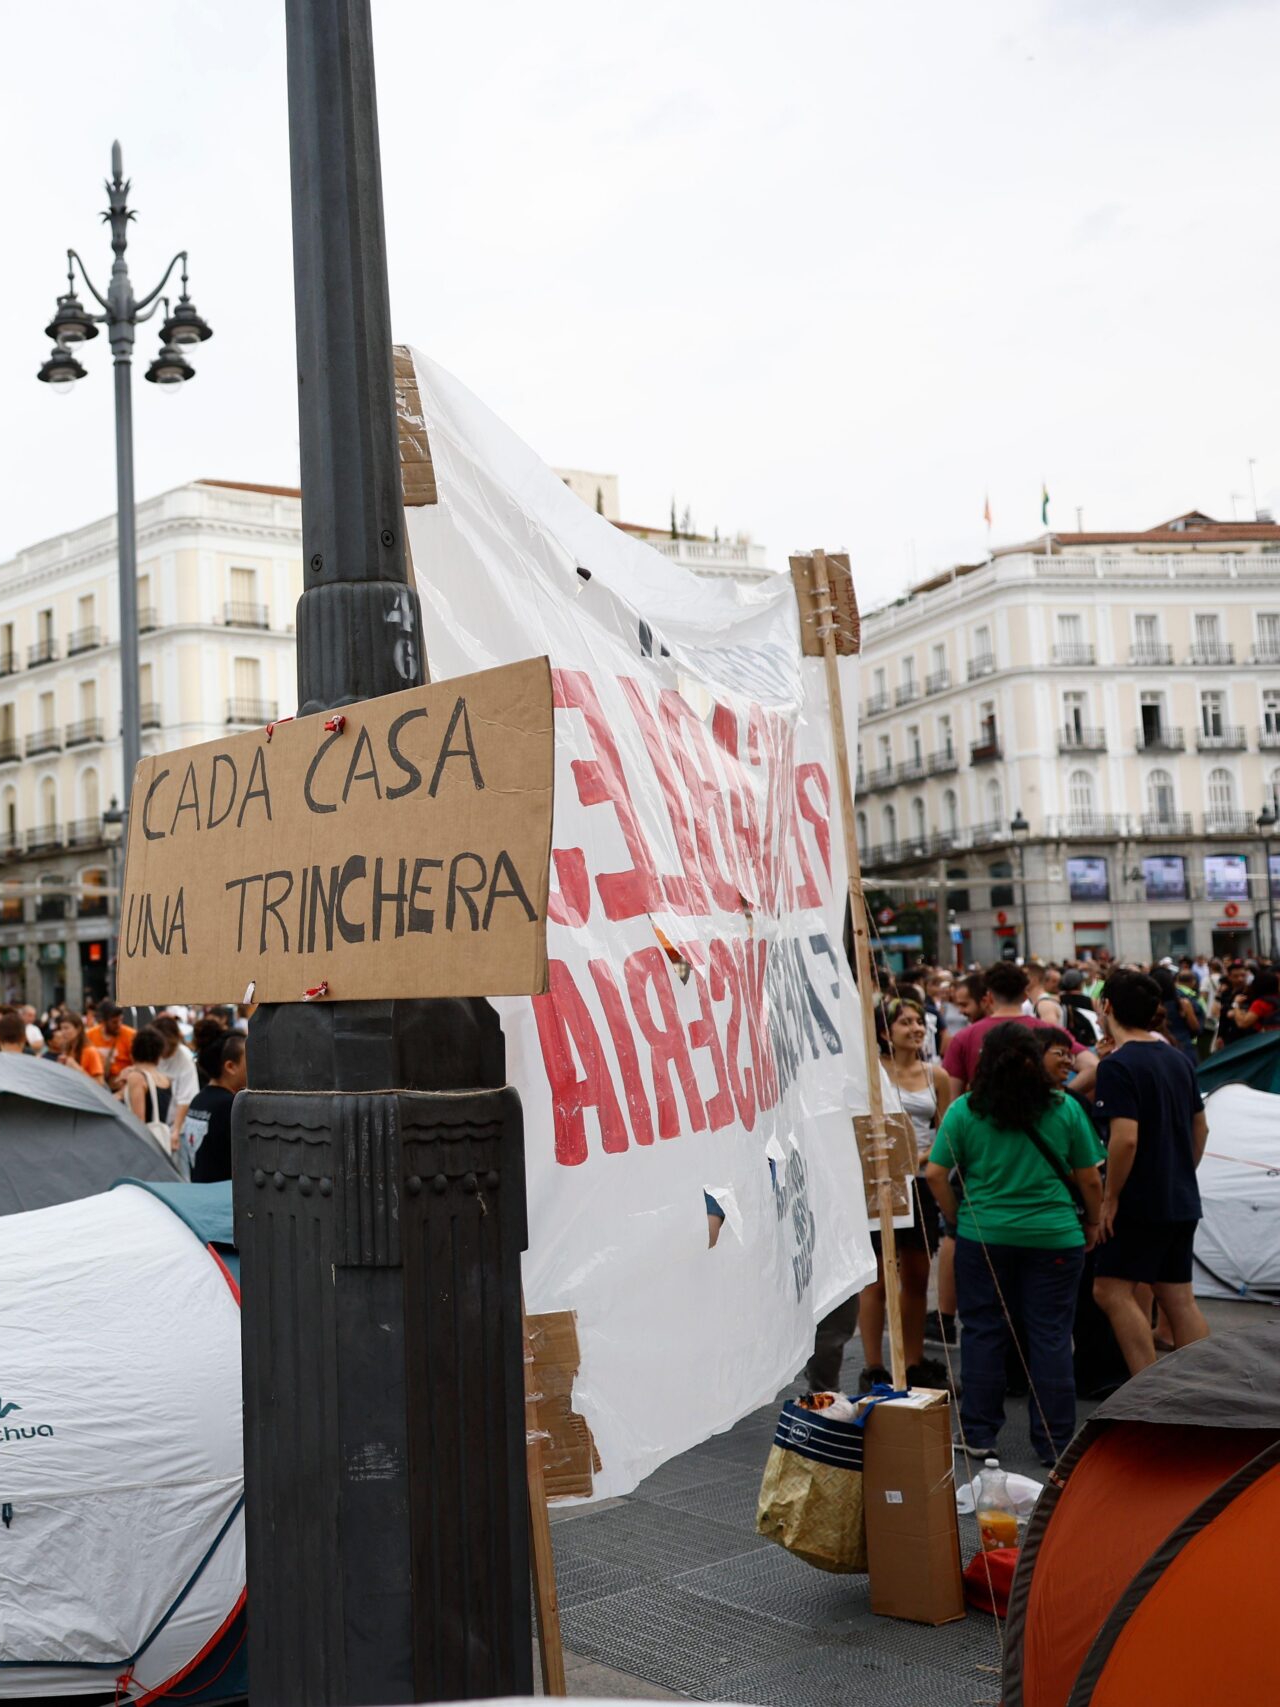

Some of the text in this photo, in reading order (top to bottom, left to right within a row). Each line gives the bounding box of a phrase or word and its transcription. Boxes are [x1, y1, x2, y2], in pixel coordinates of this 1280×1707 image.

[142, 696, 485, 841] CADA CASA
[126, 850, 539, 958] UNA TRINCHERA
